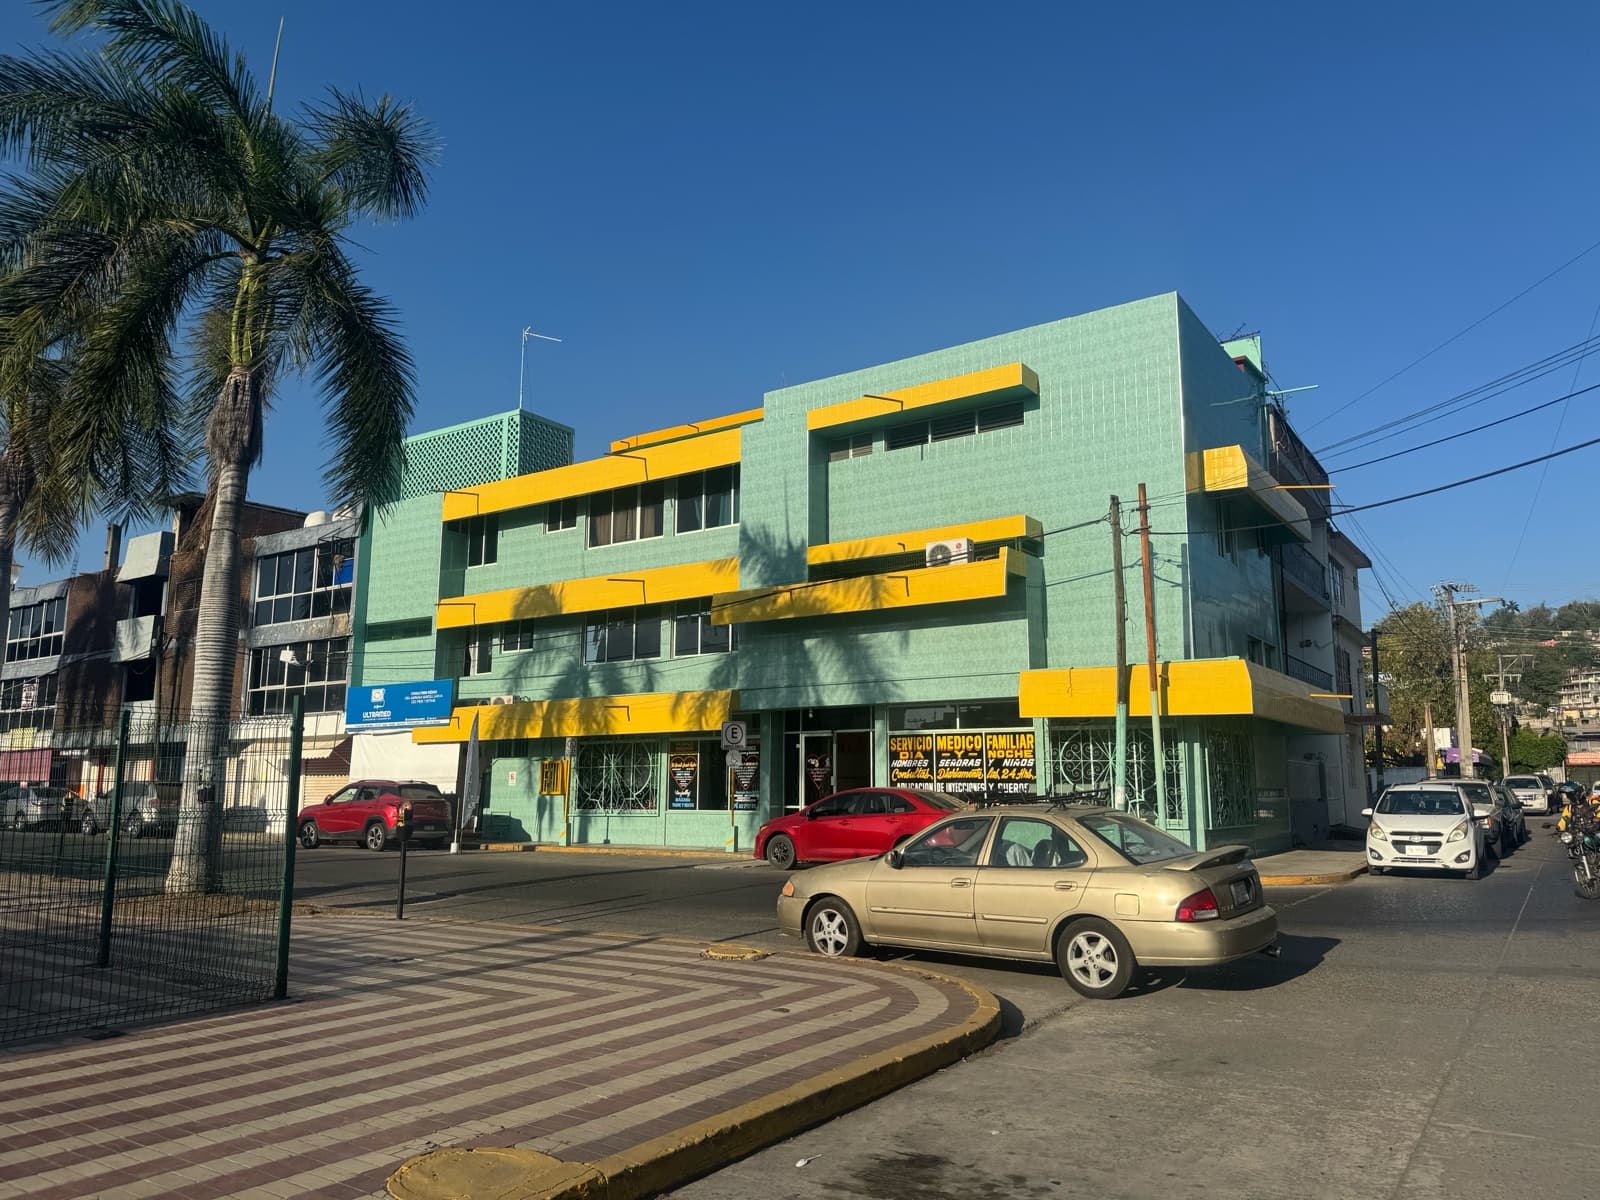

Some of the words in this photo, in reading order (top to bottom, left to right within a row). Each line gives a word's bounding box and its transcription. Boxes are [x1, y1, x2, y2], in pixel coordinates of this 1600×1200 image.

[731, 727, 738, 739] E
[890, 736, 933, 752] SERVICIO
[936, 735, 982, 752] MEDICO
[986, 734, 1034, 750] FAMILIAR
[899, 751, 924, 759] DIA
[987, 749, 1034, 758] NOCHE
[890, 759, 929, 768] HOMBRES
[938, 758, 982, 767] SEÑORAS
[987, 758, 995, 767] Y
[1002, 758, 1035, 767] NIÑOS
[1001, 768, 1016, 780] 24
[936, 782, 945, 793] DE
[987, 782, 995, 791] Y
